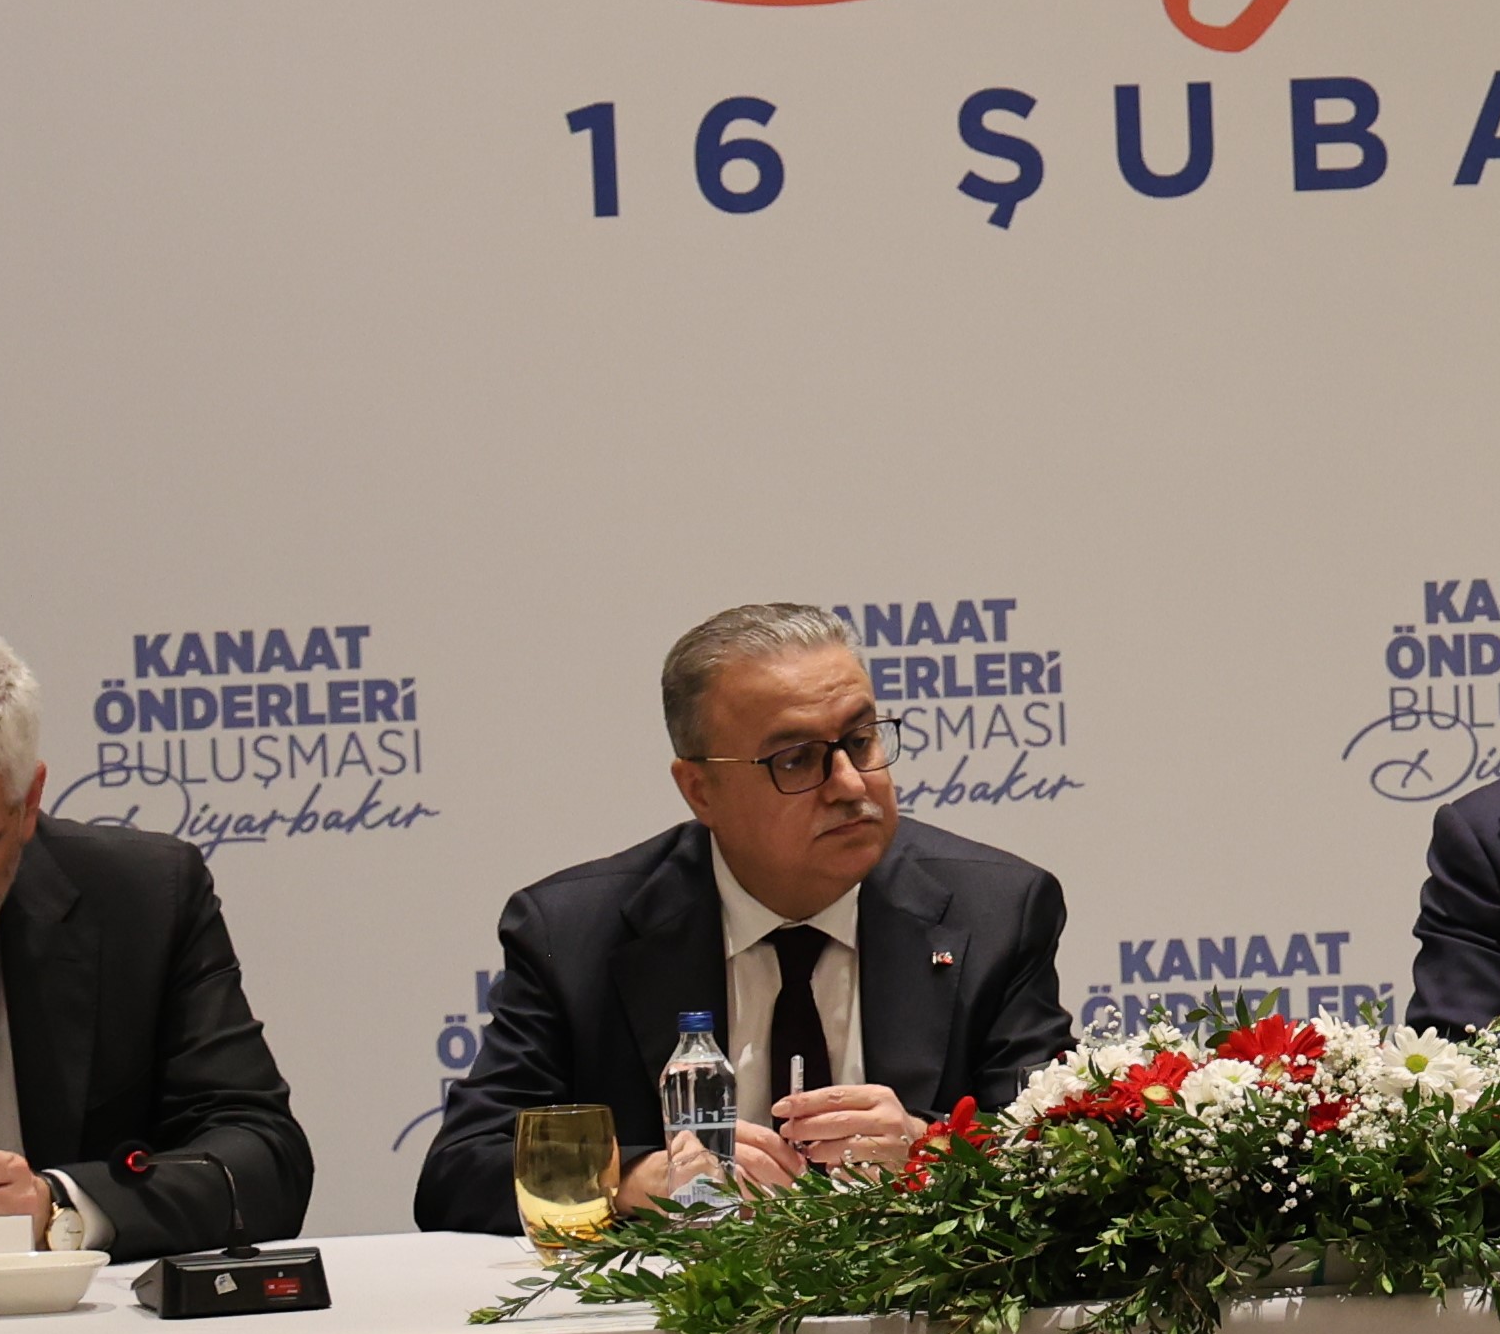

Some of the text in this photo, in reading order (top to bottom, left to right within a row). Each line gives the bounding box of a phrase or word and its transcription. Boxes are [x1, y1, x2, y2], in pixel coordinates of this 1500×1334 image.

[568, 98, 784, 218] 16
[831, 598, 1017, 647] ANAAT
[134, 625, 371, 679] KANAAT
[869, 650, 1062, 702] ERLERİ
[94, 677, 417, 734] ÖNDERLERİ
[890, 701, 1067, 760] ŞMASI
[97, 729, 422, 787] BULUŞMASI
[1119, 931, 1351, 984] KANAAT
